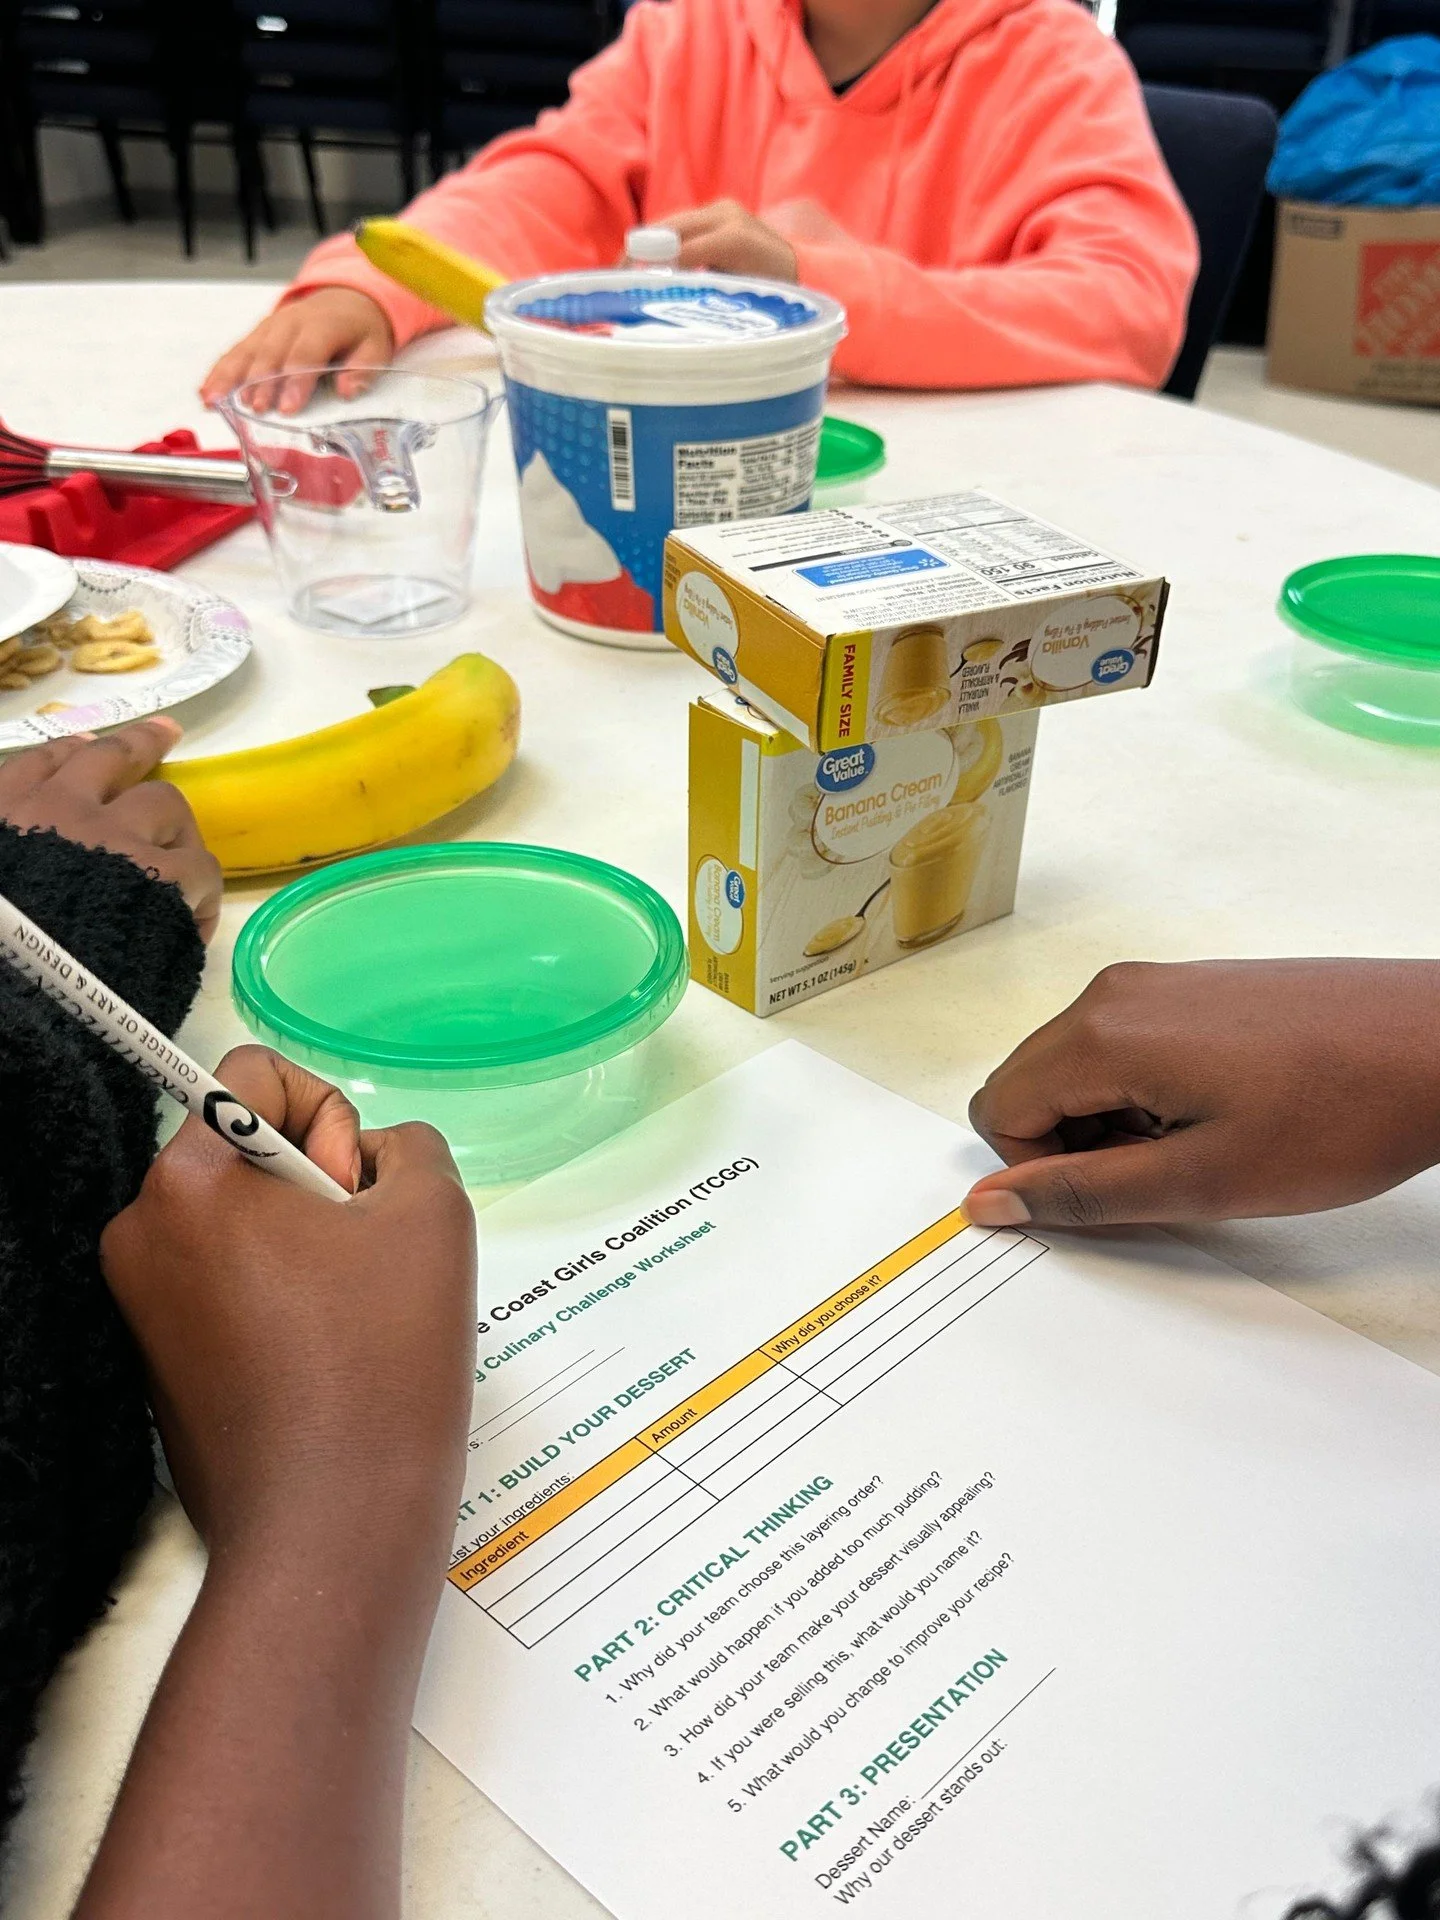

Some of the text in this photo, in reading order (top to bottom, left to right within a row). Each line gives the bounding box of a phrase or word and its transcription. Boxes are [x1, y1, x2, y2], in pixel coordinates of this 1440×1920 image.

[981, 567, 1010, 576] 150
[1014, 562, 1036, 570] 90
[1014, 584, 1062, 596] Facts
[1064, 571, 1137, 587] Nutrition
[1042, 635, 1089, 654] Vanilla
[1098, 662, 1129, 678] Great
[839, 644, 856, 738] FAMILY SIZE
[823, 748, 865, 774] Great
[825, 774, 942, 826] Banana Cream
[832, 765, 865, 783] Value
[713, 863, 722, 942] Banana Cream
[14, 924, 199, 1084] COLLEGE OF ART & DESIGN
[769, 991, 786, 1004] NET
[788, 983, 802, 997] WT
[818, 974, 828, 984] OZ
[830, 960, 857, 980] (145g)
[770, 956, 830, 984] serving suggestion
[490, 1156, 760, 1322] Coast Girls Coalition (TCGC)
[483, 1220, 717, 1370] Culinary Challenge Worksheet
[771, 1274, 882, 1354] Why did you choose it?
[478, 1348, 698, 1504] 1: BUILD YOUR DESSERT
[651, 1407, 698, 1444] Amount
[470, 1524, 500, 1549] your
[500, 1472, 575, 1521] ingredients:
[460, 1530, 530, 1582] Ingredient
[574, 1474, 834, 1682] PART 2: CRITICAL THINKING
[605, 1474, 885, 1705] 1. Why did your team choose this layering order?
[633, 1470, 944, 1732] 2. What would happen if you added too much pudding?
[664, 1470, 997, 1758] 3. How did your team make your dessert visually appealing?
[698, 1529, 984, 1784] 4. If you were selling this, what would you name it?
[726, 1552, 1016, 1813] 5. What would you change to improve your recipe?
[778, 1648, 1010, 1862] PART 3: PRESENTATION
[814, 1794, 916, 1890] Dessert Name:
[833, 1738, 1009, 1905] Why our dessert stands out:
